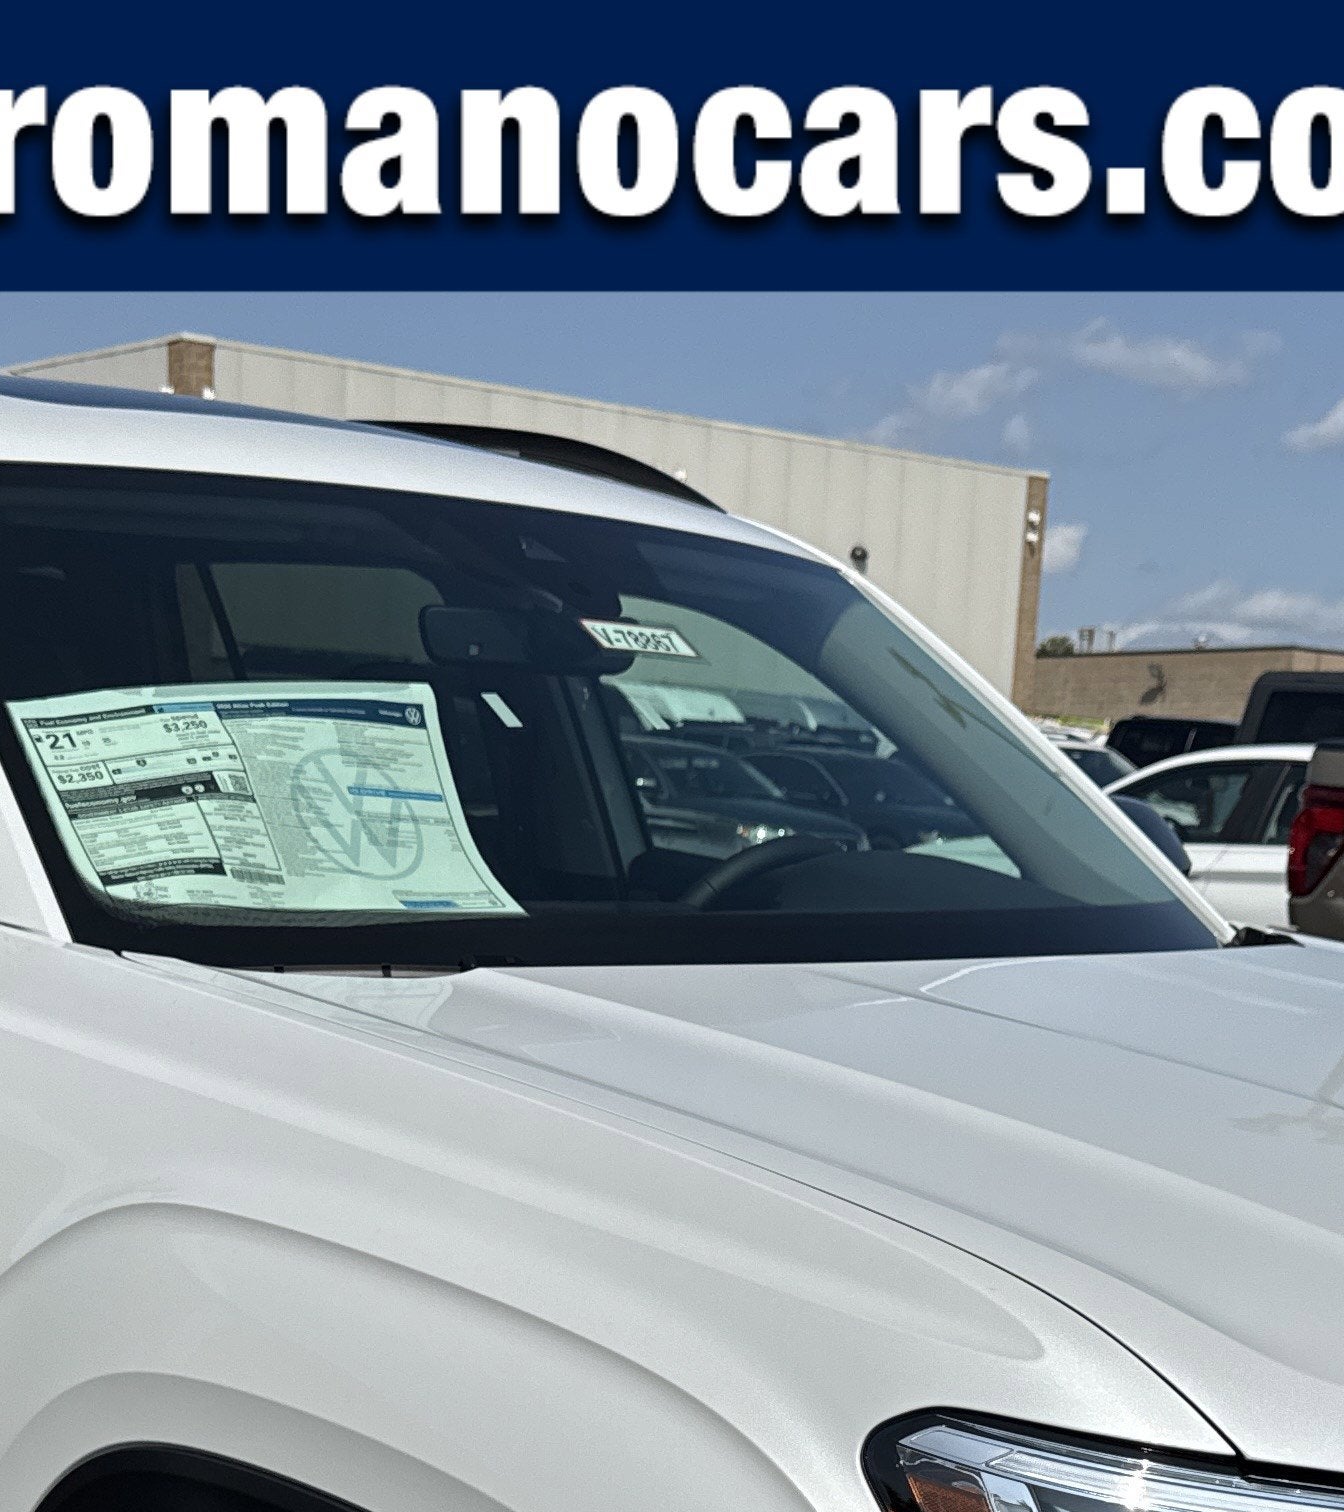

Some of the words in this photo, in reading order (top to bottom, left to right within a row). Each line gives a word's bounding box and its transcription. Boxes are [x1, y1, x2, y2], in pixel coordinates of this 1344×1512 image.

[162, 720, 207, 734] $3,250
[46, 732, 78, 750] 21
[57, 770, 104, 785] $2,350
